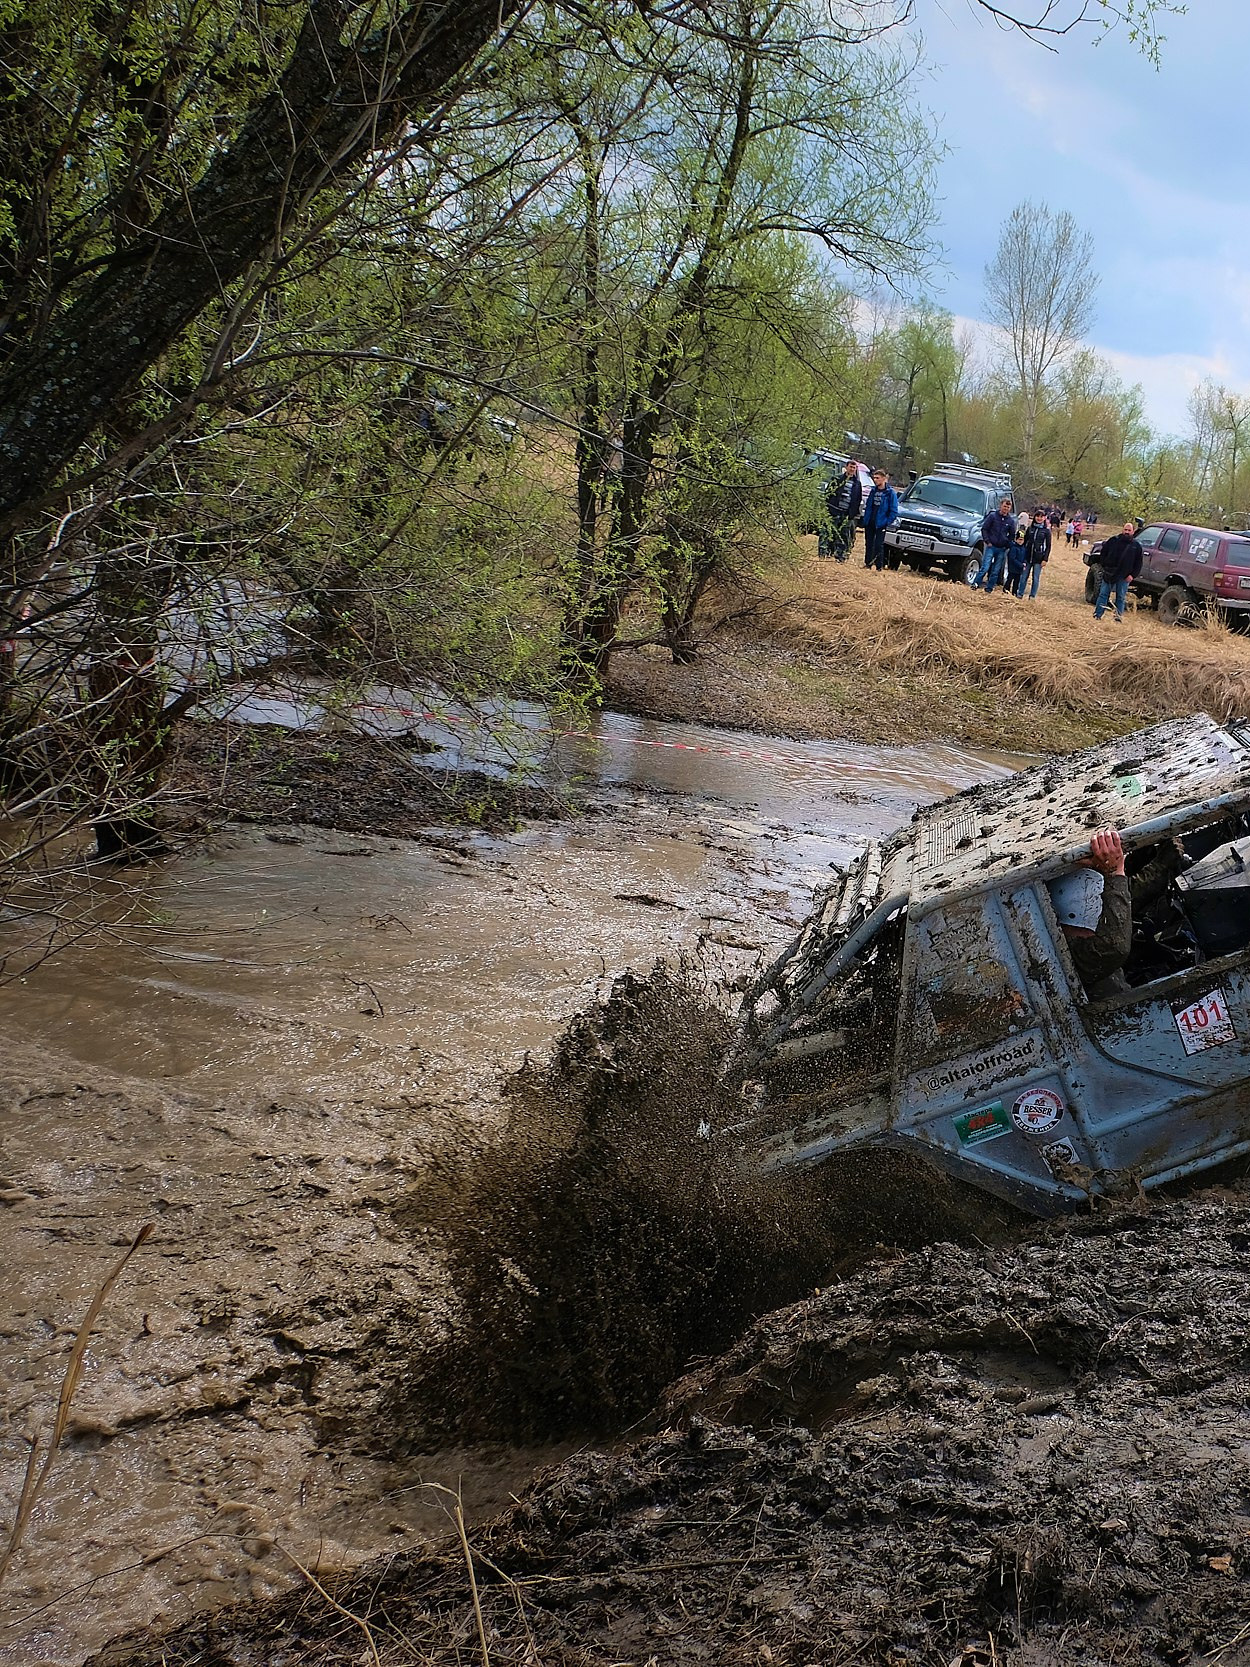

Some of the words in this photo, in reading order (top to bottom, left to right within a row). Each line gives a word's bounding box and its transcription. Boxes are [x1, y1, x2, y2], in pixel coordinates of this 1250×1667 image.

[1180, 1000, 1221, 1032] 101
[927, 1042, 1033, 1090] @altaioffroad
[1024, 1105, 1052, 1116] BESSER
